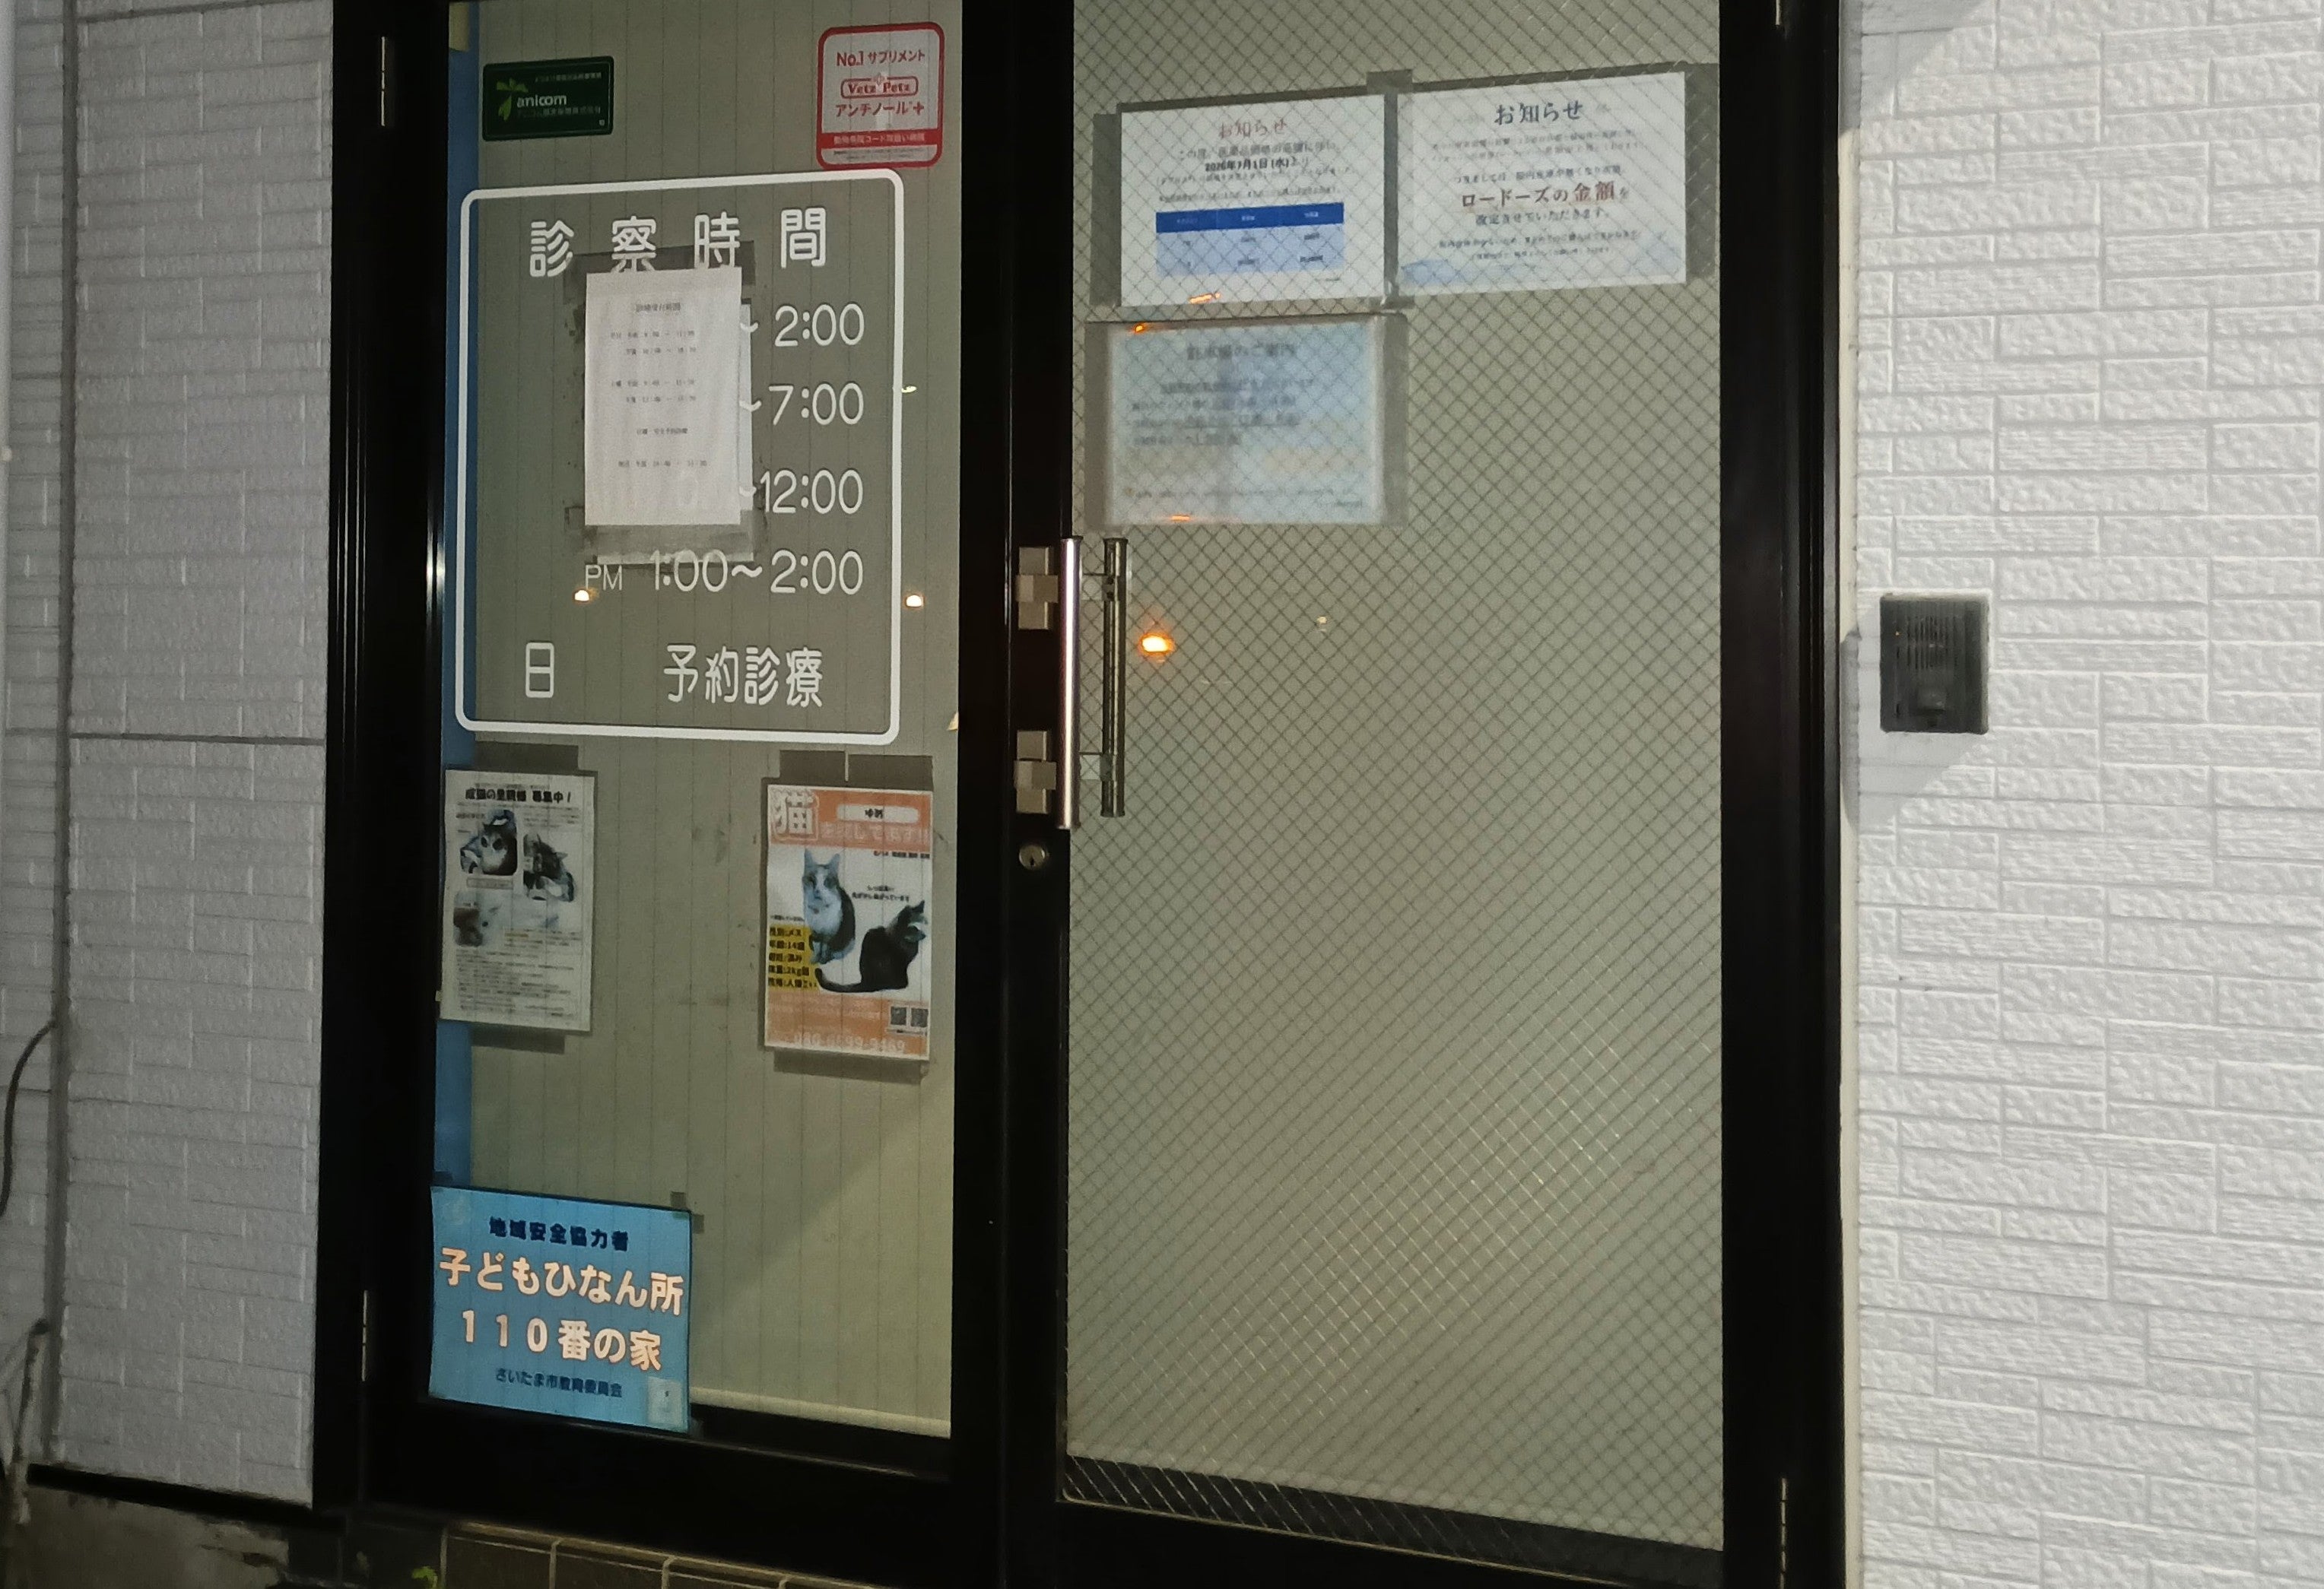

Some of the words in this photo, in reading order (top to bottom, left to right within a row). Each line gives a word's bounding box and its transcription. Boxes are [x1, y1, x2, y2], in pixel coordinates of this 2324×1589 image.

[837, 51, 864, 66] No.1
[1494, 100, 1583, 126] お知らせ
[1219, 118, 1287, 139] お知らせ
[584, 566, 623, 591] PM
[525, 642, 555, 698] 日
[663, 644, 824, 708] 予約診療
[489, 1216, 629, 1251] 地域安全協力者
[439, 1248, 684, 1317] 子どもひなん所
[462, 1309, 662, 1371] 110番の家
